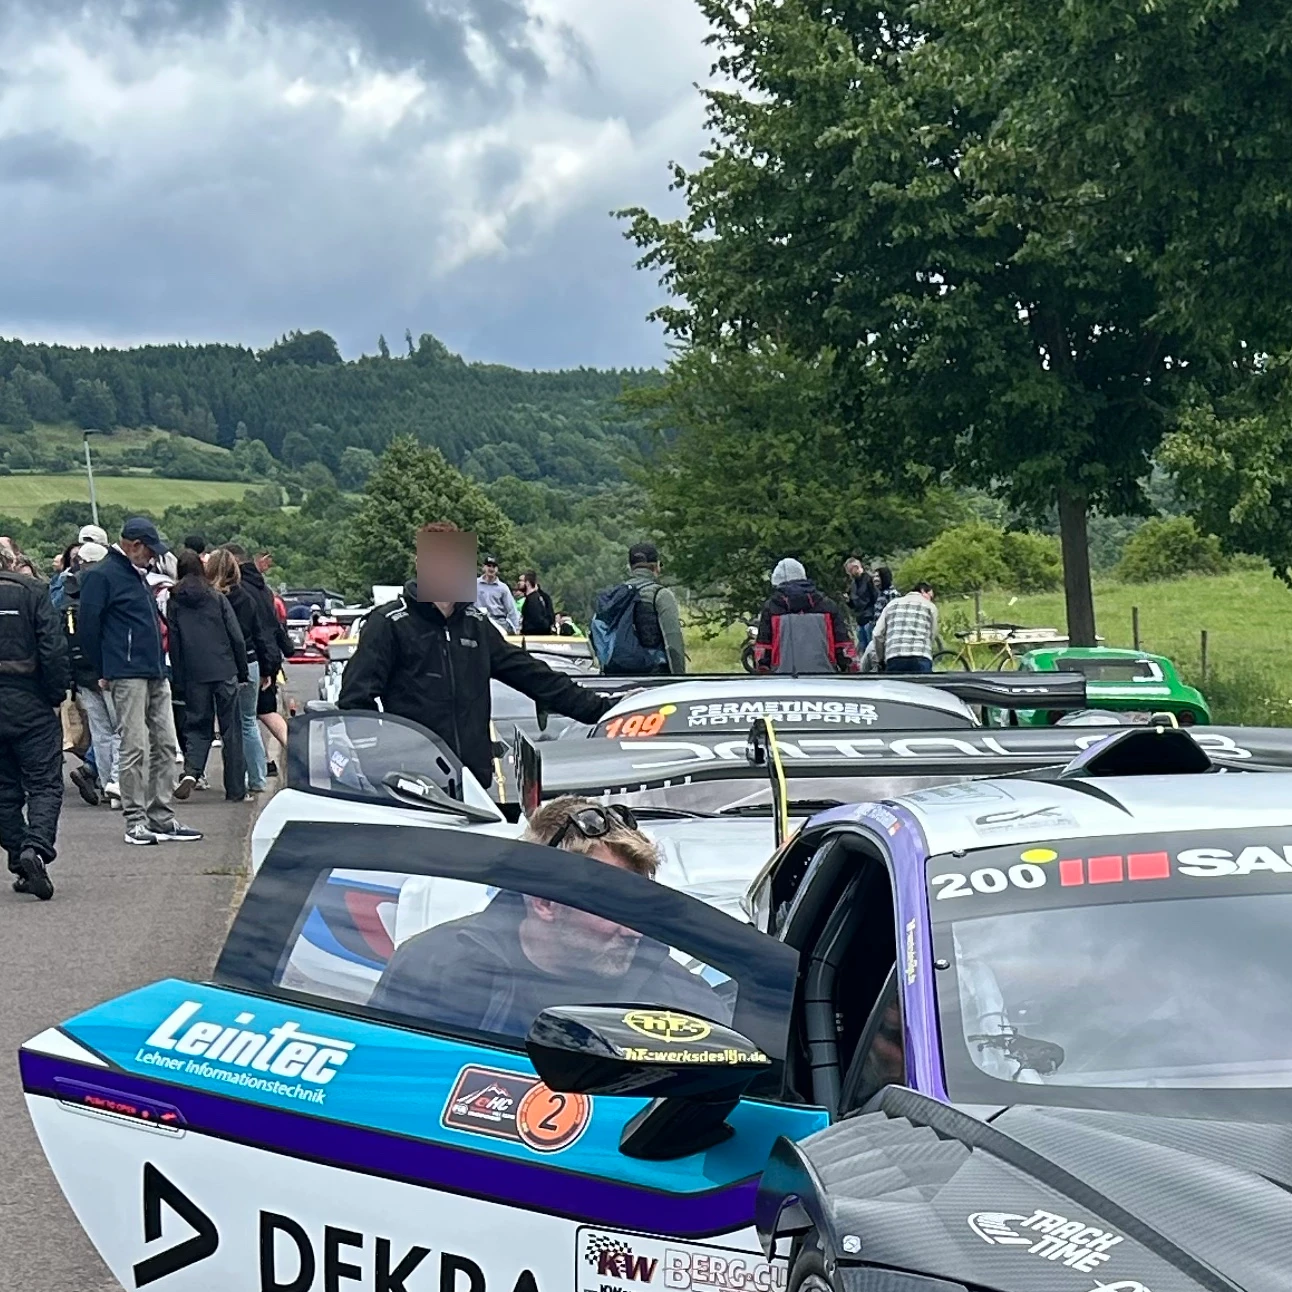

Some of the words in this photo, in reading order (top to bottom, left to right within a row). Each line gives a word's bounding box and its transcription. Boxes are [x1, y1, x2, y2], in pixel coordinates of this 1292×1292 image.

[605, 713, 666, 739] 199
[689, 701, 877, 717] PERMETINGER
[931, 862, 1047, 899] 200
[144, 1000, 357, 1085] Leintec
[134, 1048, 184, 1075] Lehner
[184, 1059, 328, 1105] Informationstechnik
[538, 1094, 567, 1131] 2
[1020, 1209, 1124, 1251] TRACK
[598, 1250, 660, 1285] KW
[1028, 1234, 1111, 1273] TIME
